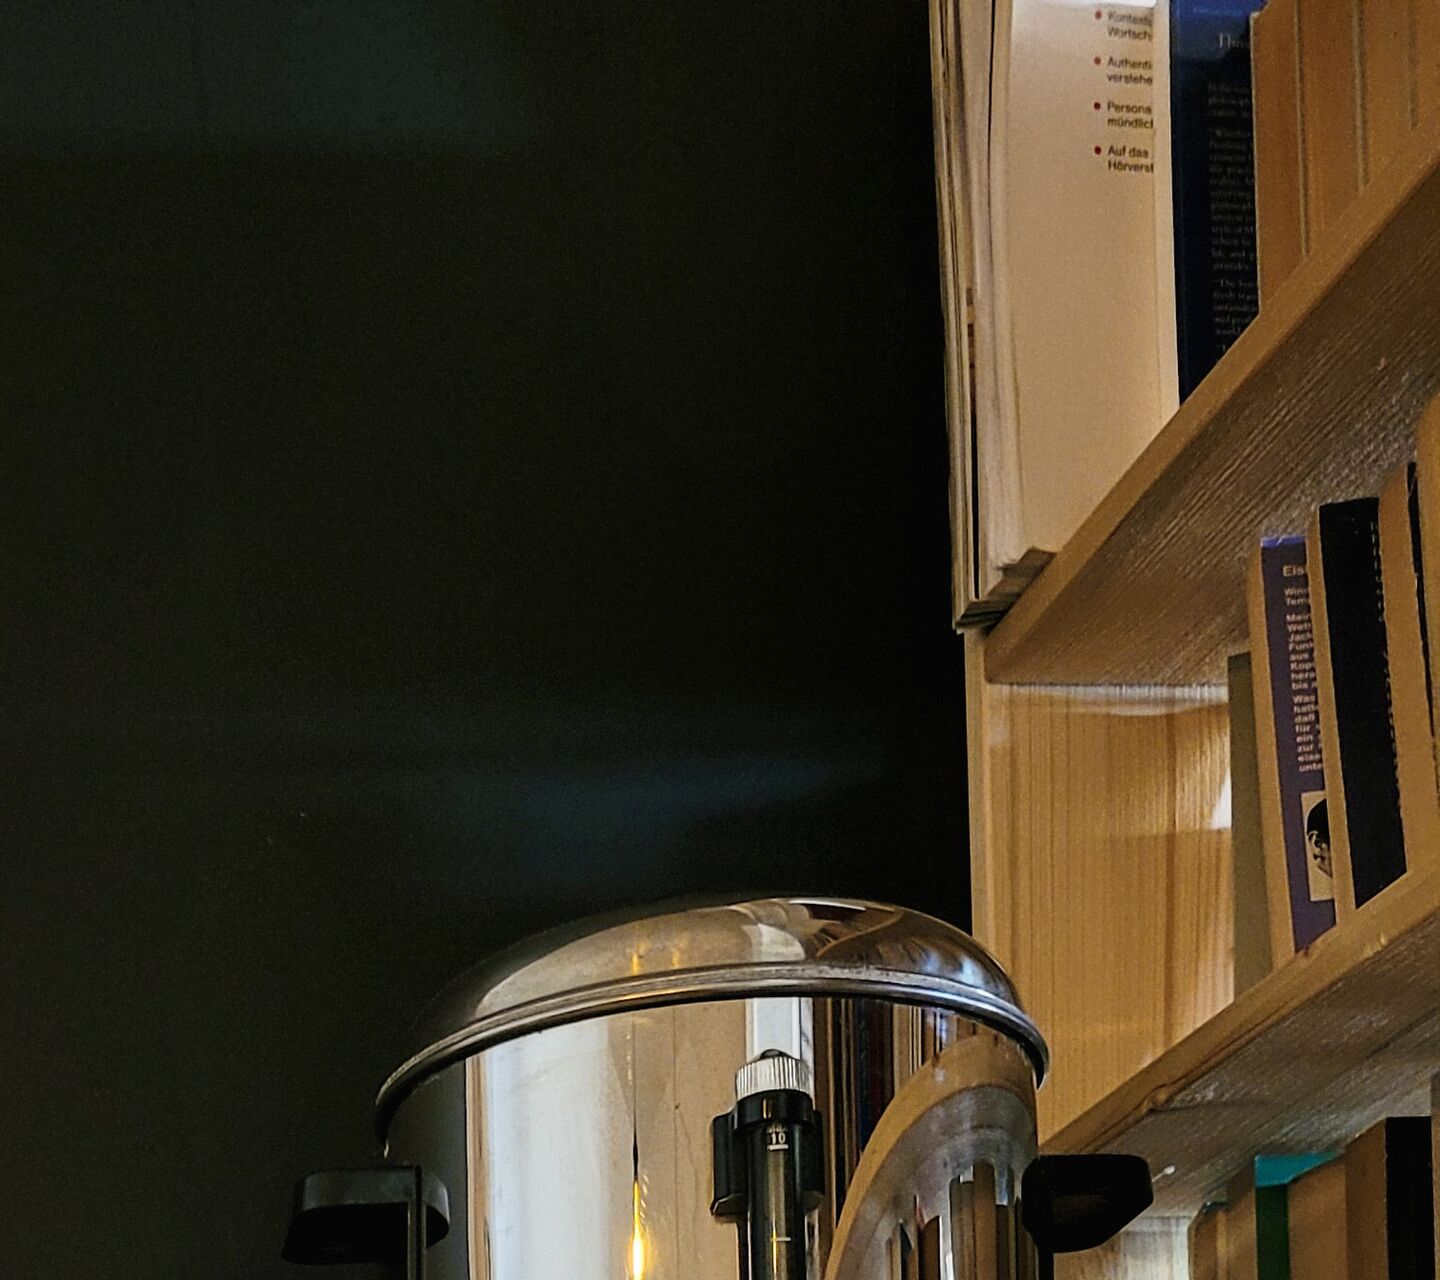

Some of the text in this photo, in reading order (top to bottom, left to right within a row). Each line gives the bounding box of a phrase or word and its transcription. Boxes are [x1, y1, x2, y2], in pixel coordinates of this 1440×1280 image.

[1108, 145, 1148, 159] Auf das
[771, 1132, 786, 1145] 10
